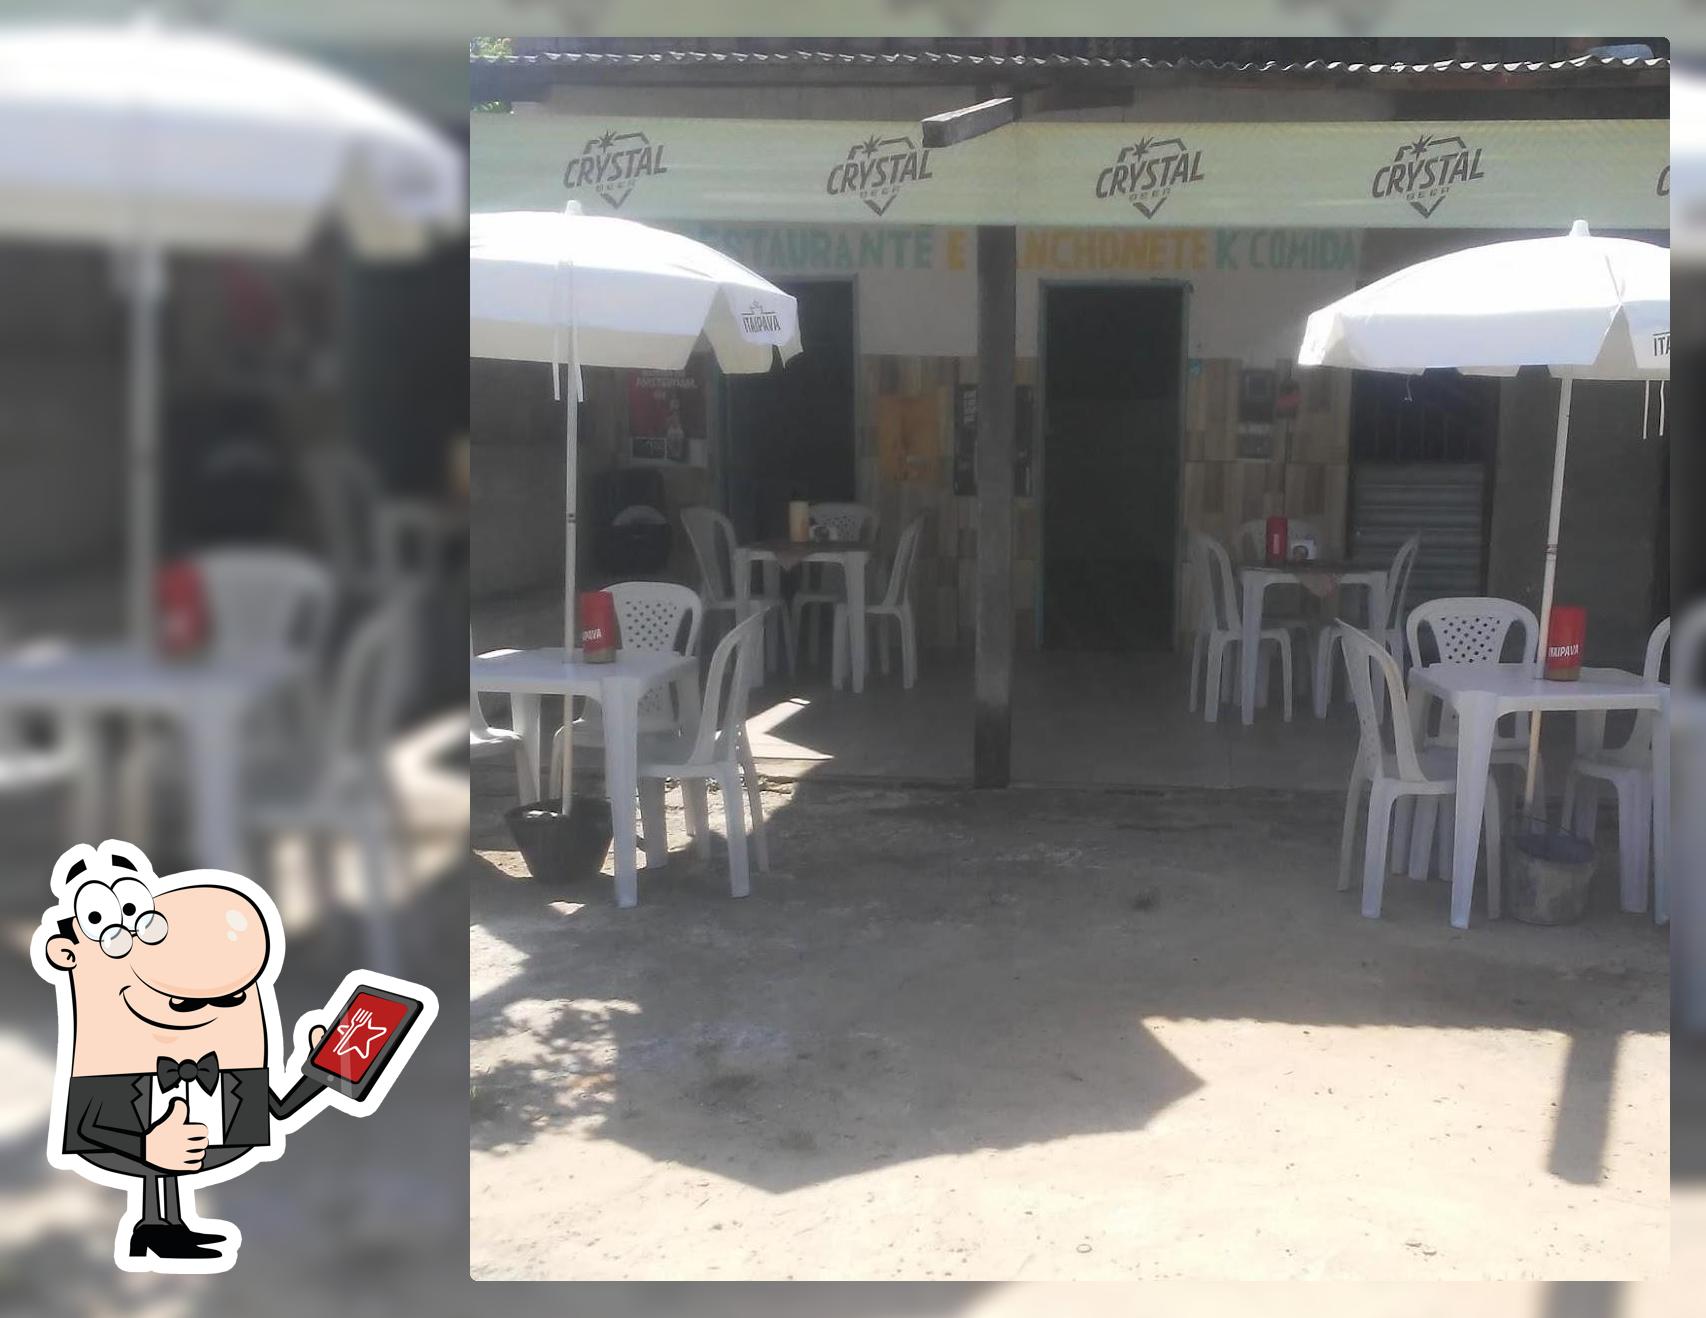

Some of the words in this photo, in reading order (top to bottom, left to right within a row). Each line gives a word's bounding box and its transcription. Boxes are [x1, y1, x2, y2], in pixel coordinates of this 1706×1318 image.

[563, 144, 667, 189] CRYSTAL
[827, 149, 933, 195] CRYSTAL
[1096, 151, 1205, 198] CRYSTAL
[1372, 148, 1485, 198] CRYSTAL
[947, 229, 967, 270] E
[1015, 228, 1207, 271] NCHONETE
[1215, 227, 1239, 271] K
[1249, 228, 1357, 270] COMIDA
